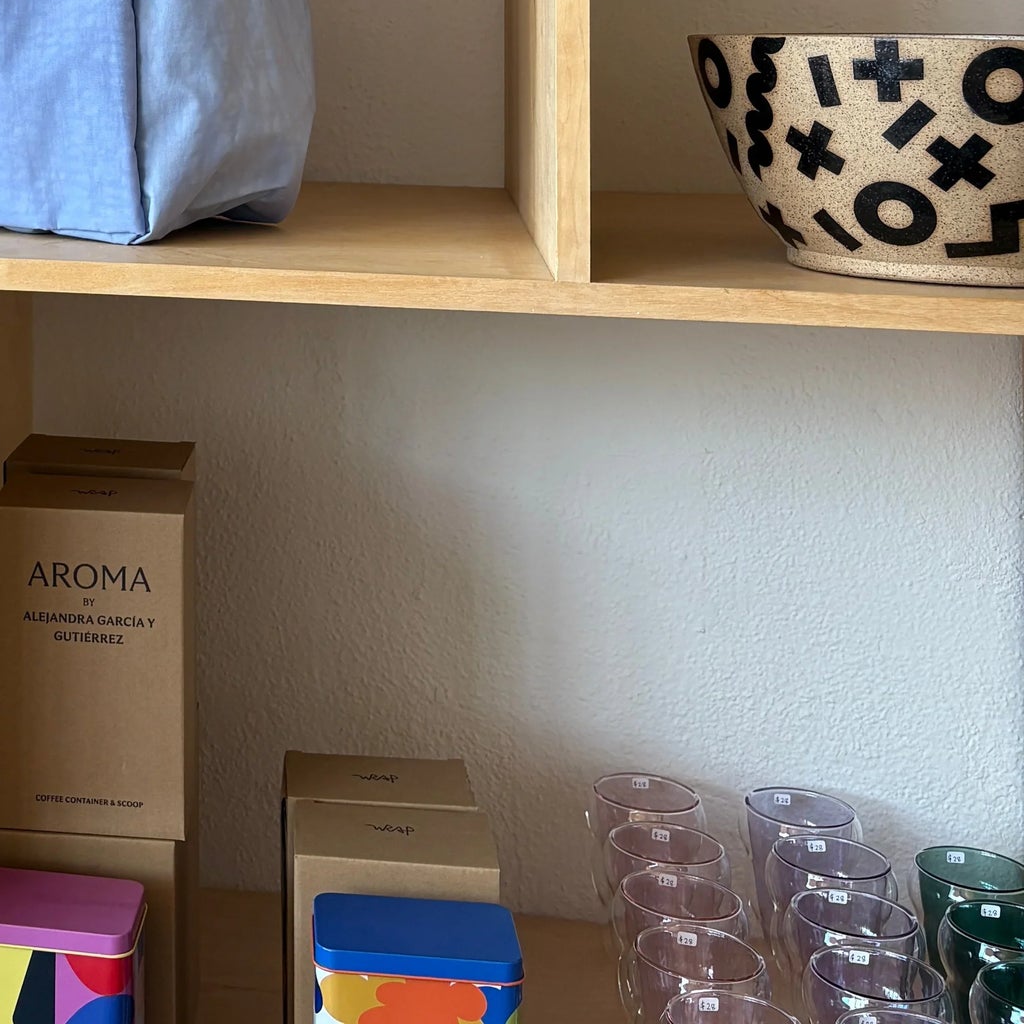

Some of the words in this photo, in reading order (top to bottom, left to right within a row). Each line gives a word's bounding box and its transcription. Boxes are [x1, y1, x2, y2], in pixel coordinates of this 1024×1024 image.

[27, 561, 151, 593] AROMA
[82, 598, 95, 607] BY
[23, 611, 94, 625] ALEJANDRA
[97, 615, 144, 628] GARCÍA
[147, 618, 156, 628] Y
[54, 630, 124, 645] GUTIÉRREZ
[36, 794, 64, 803] COFFEE
[65, 796, 108, 806] CONTAINER
[117, 800, 144, 808] SCOOP
[851, 954, 866, 963] $28
